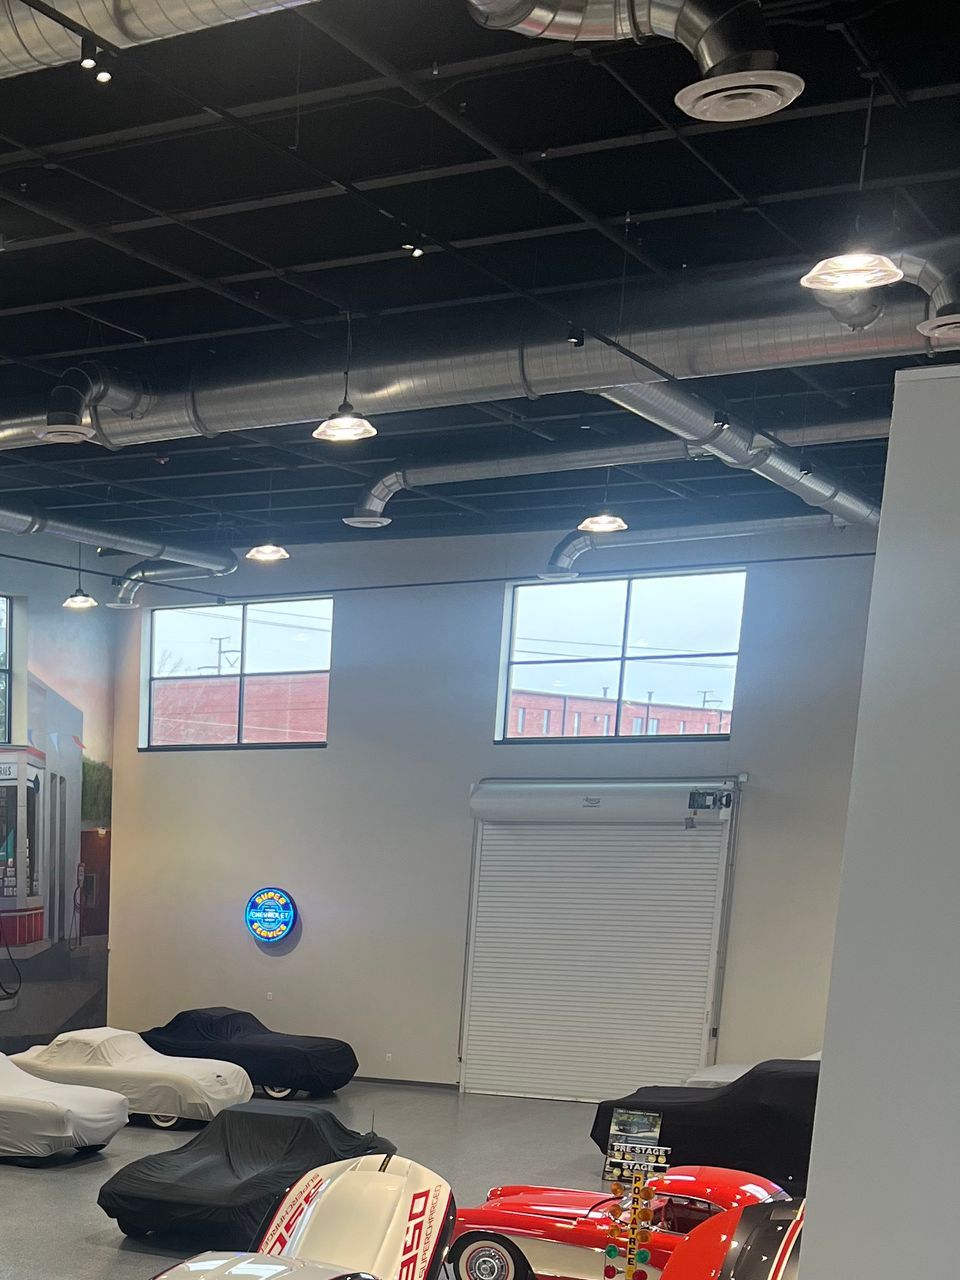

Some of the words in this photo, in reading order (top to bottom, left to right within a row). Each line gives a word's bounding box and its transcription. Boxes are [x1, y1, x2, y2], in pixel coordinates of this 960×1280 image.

[251, 911, 289, 919] CHEVROLET
[614, 1145, 666, 1156] PRE-STAGE
[622, 1163, 654, 1172] STAGE
[628, 1175, 641, 1266] PORTATREE
[418, 1184, 442, 1279] SUPERCHARGED
